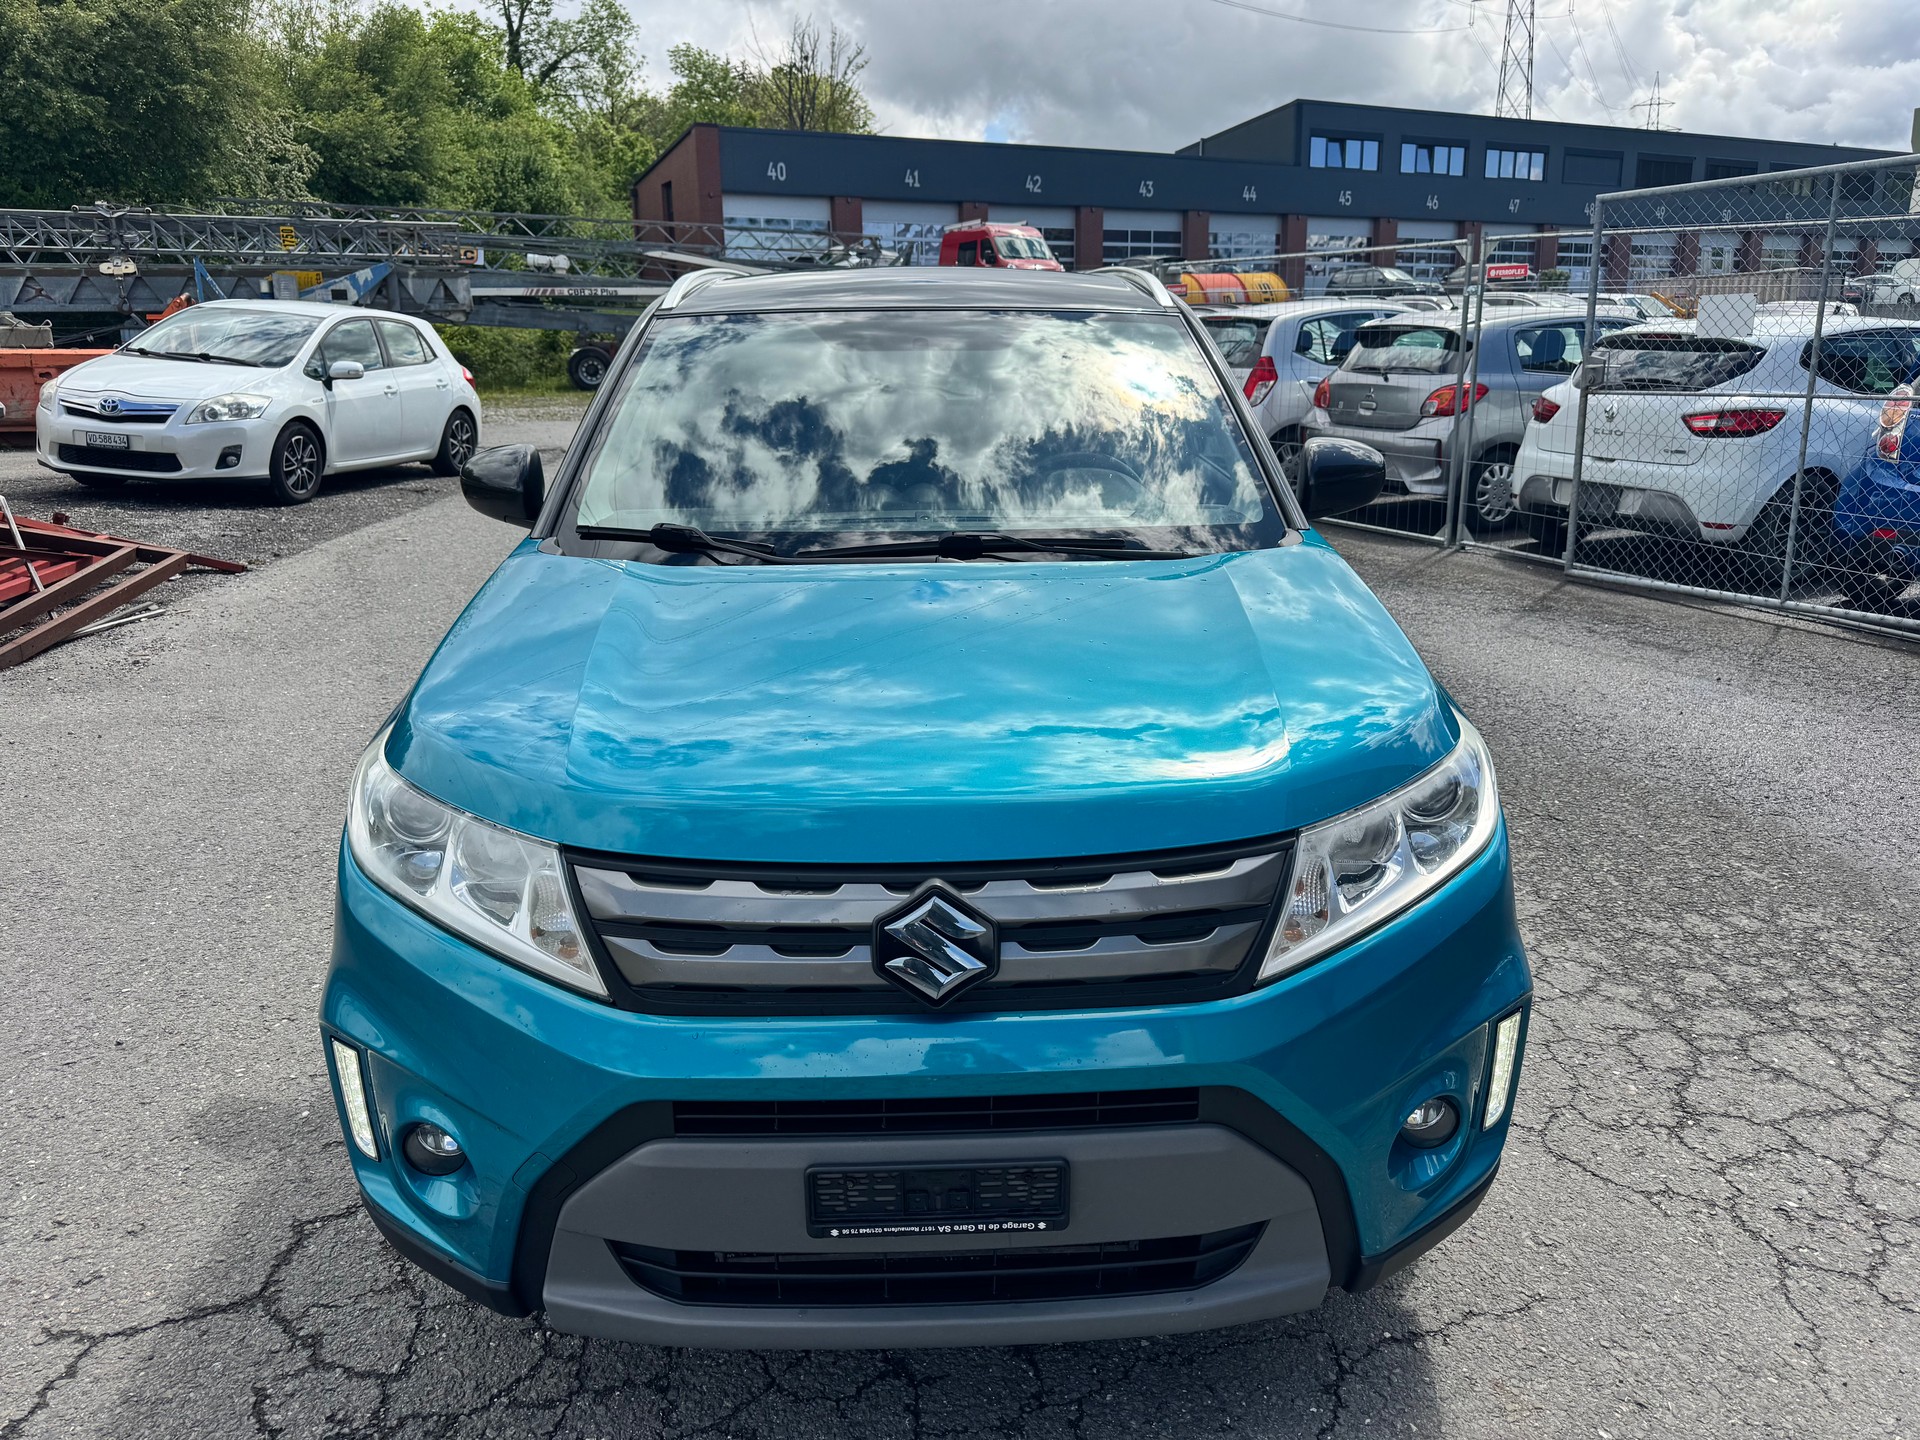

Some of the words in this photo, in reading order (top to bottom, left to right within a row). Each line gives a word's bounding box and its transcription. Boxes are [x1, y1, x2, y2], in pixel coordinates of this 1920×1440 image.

[767, 162, 786, 181] 40
[904, 168, 921, 188] 41
[1025, 174, 1042, 193] 42
[1139, 180, 1154, 198] 43
[1242, 185, 1257, 202] 44
[1338, 190, 1352, 206] 45
[1426, 194, 1439, 210] 46
[1508, 198, 1520, 214] 47
[1584, 202, 1595, 217] 48
[1655, 206, 1666, 220] 49
[1496, 268, 1525, 276] FERROFLEX
[588, 288, 598, 296] 32
[600, 288, 618, 296] Plus
[1593, 428, 1624, 437] CLIO
[937, 1225, 951, 1233] SA
[953, 1224, 976, 1232] Gare
[988, 1223, 1000, 1231] de
[1002, 1221, 1035, 1230] Garage
